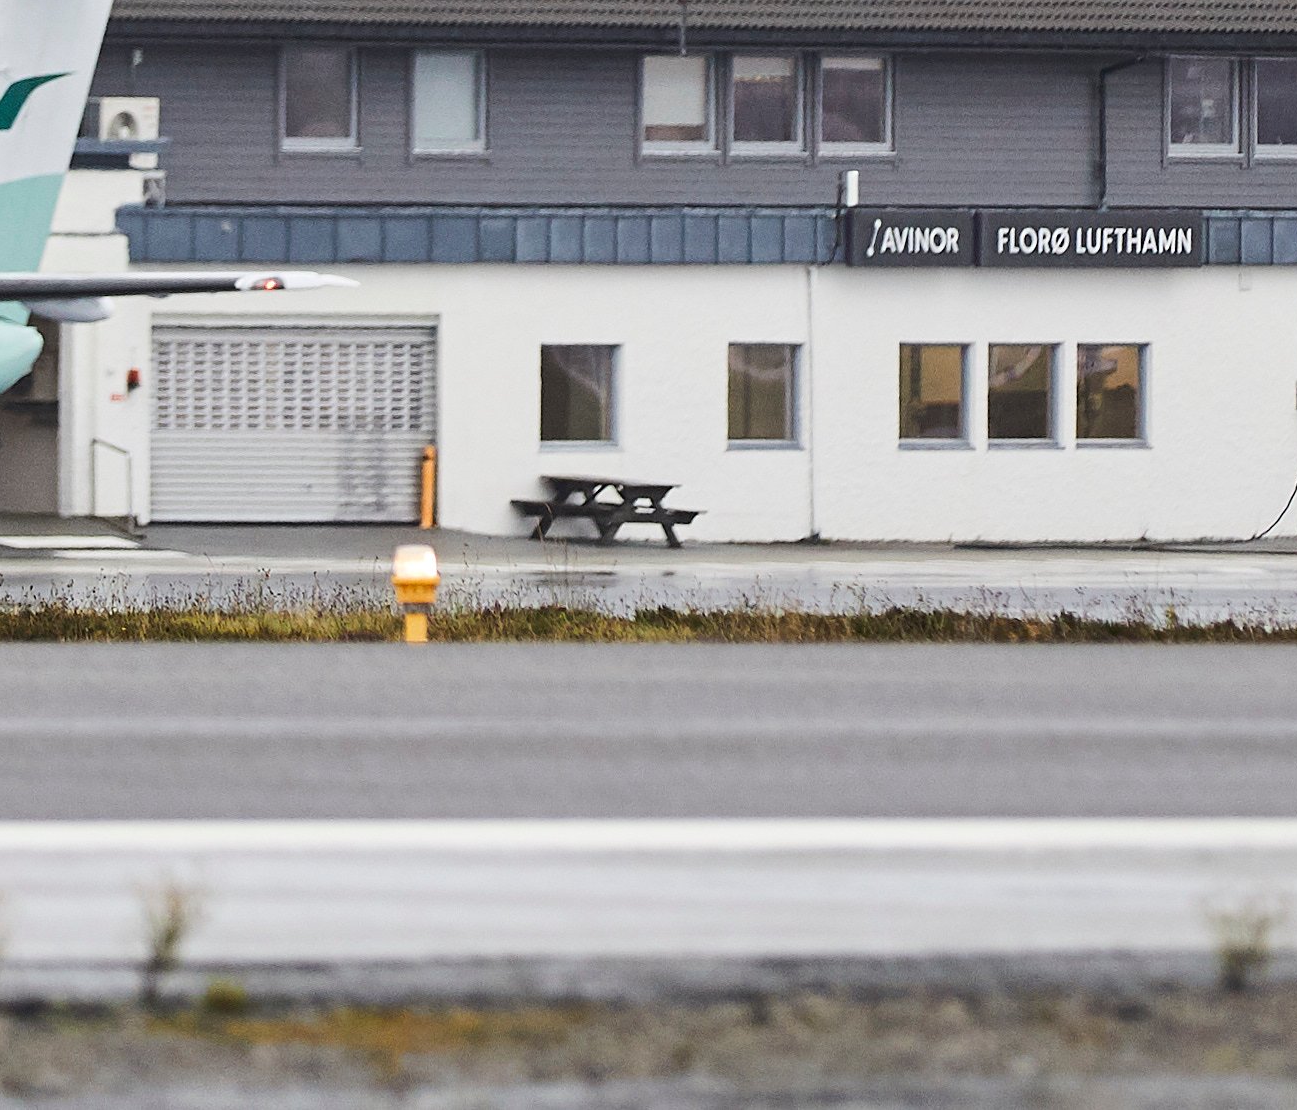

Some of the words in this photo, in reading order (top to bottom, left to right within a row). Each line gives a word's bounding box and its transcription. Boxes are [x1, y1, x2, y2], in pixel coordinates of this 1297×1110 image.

[880, 226, 960, 254] AVINOR
[997, 226, 1070, 255] FLORØ
[1075, 226, 1193, 255] LUFTHAMN
